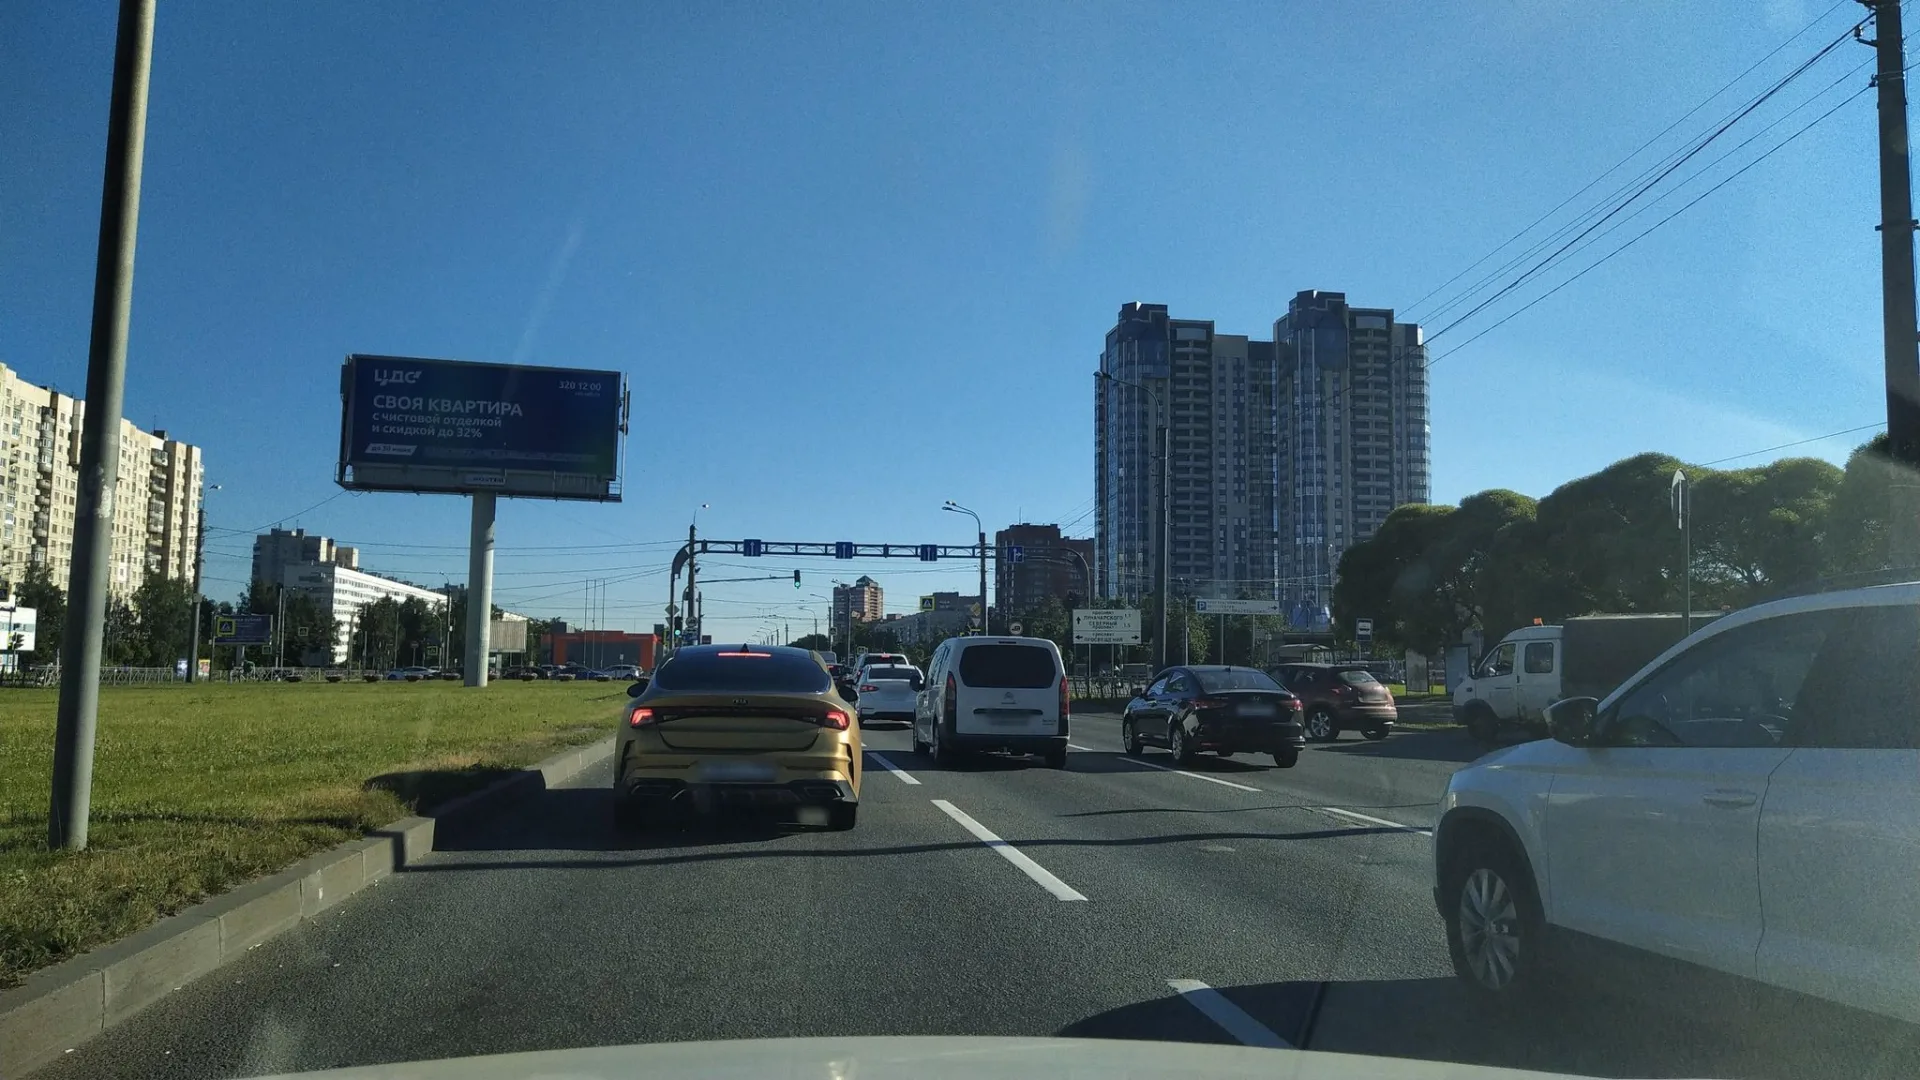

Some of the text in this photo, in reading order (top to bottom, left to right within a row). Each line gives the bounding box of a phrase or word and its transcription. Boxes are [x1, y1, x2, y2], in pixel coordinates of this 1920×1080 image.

[374, 369, 422, 386] ЦДС
[558, 380, 602, 392] 320 12 00
[373, 394, 523, 417] СВОЯ КВАРТИРА
[382, 411, 441, 425] чистовой
[443, 415, 502, 429] отделкой
[372, 424, 483, 439] и скидкой до 32%
